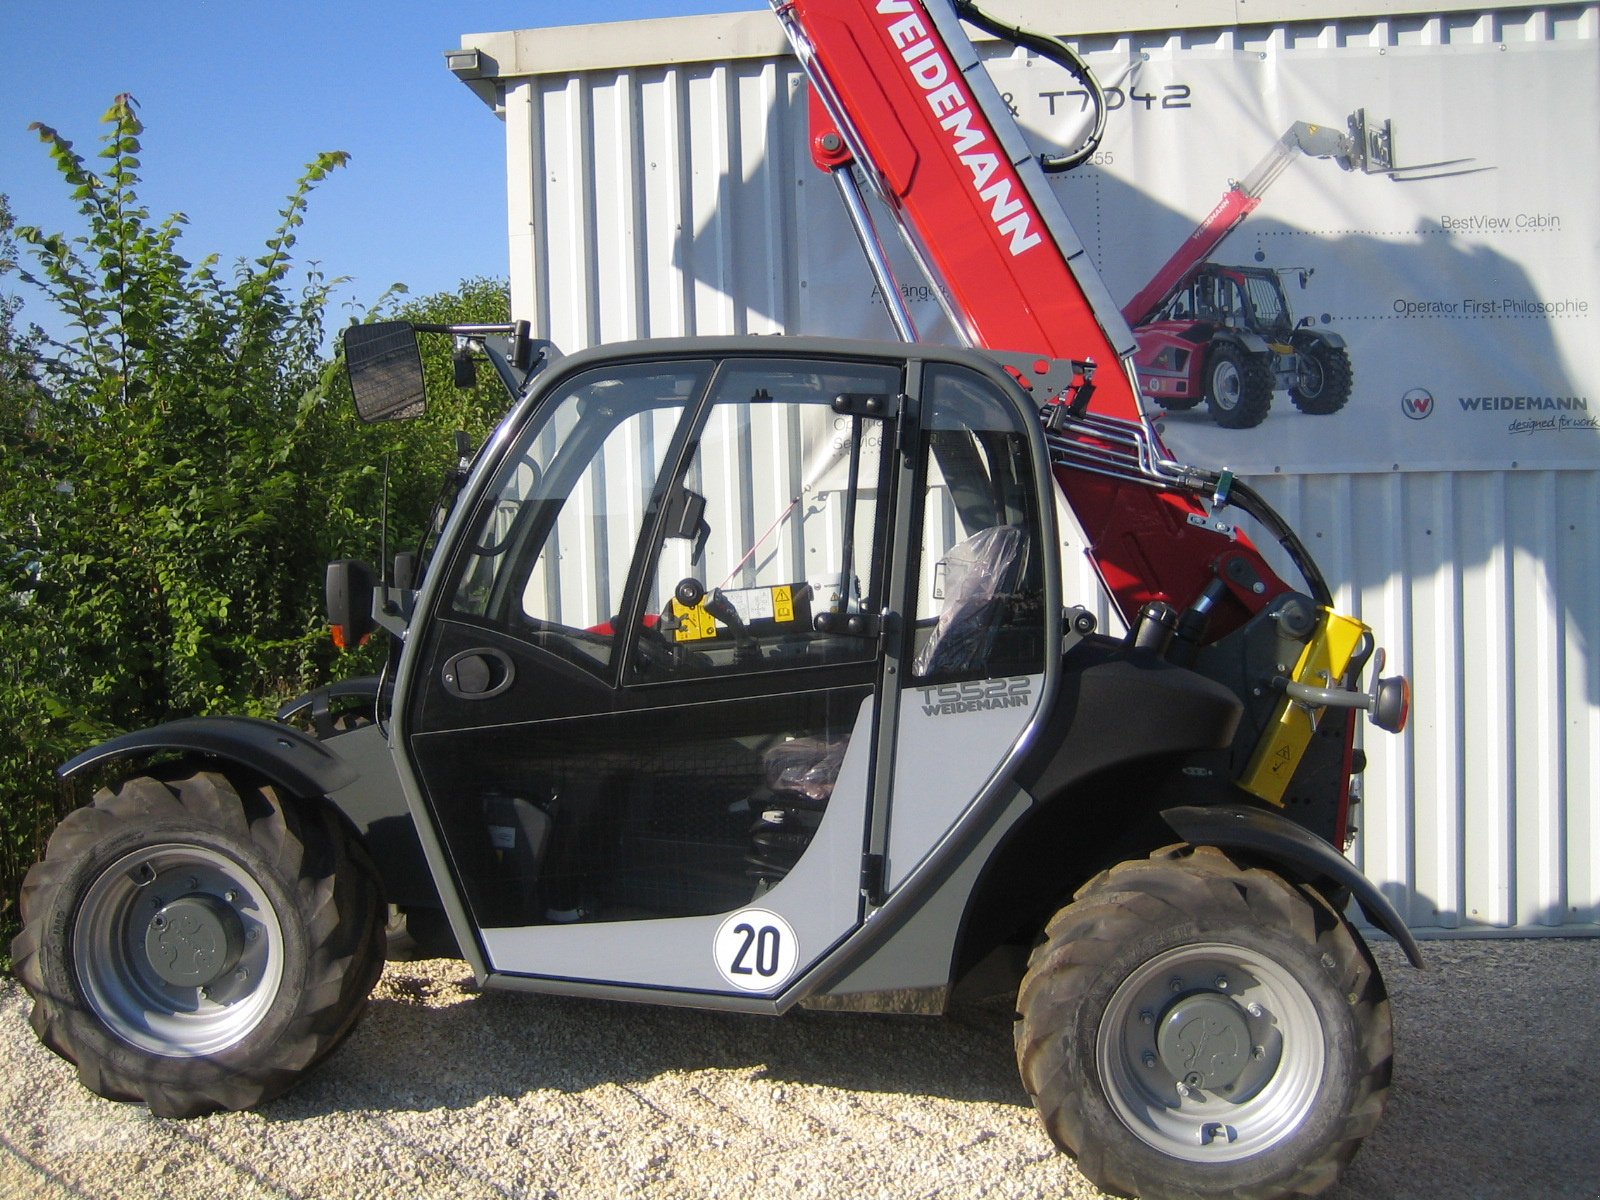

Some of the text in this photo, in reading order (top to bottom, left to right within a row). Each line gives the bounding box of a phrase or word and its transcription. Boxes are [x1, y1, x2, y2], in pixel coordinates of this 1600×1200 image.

[1038, 84, 1192, 116] T7042
[1441, 213, 1561, 230] BestView Cabin
[1393, 298, 1589, 315] Operator First-Philosophie
[1458, 396, 1588, 412] WEIDEMANN
[1508, 415, 1556, 436] designed
[916, 676, 1032, 705] T5522
[921, 695, 1029, 717] WEIDEMANN
[731, 923, 781, 977] 20
